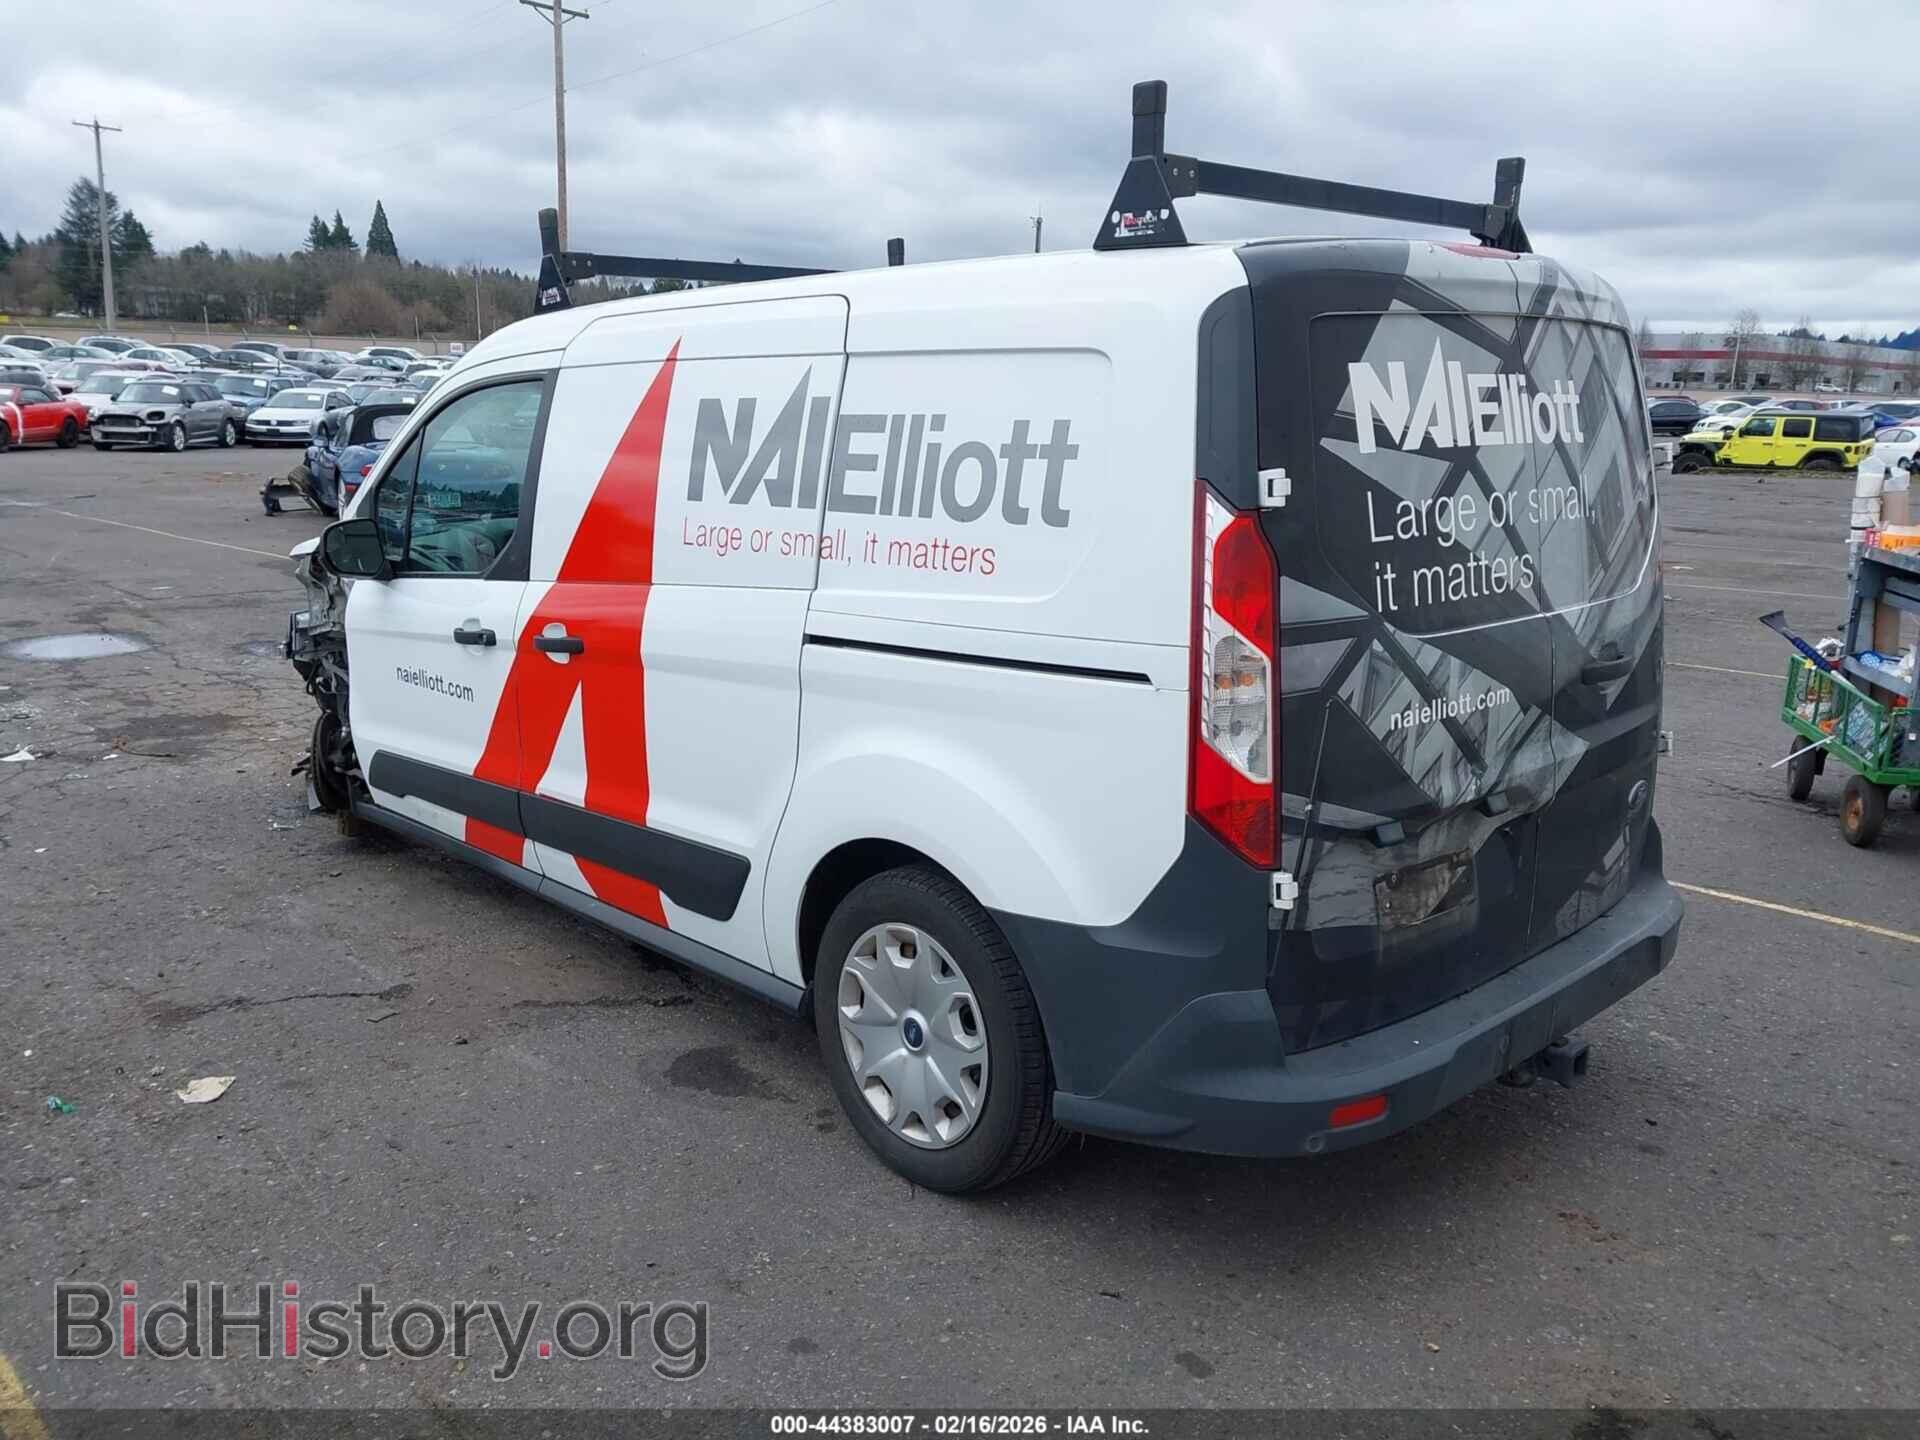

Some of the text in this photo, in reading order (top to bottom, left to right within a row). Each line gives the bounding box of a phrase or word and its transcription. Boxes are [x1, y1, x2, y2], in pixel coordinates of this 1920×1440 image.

[1366, 473, 1597, 547] Large or small,
[682, 516, 996, 575] Large or small, it matters
[1375, 552, 1535, 613] it matters
[396, 665, 474, 703] naielliott.com
[1390, 686, 1511, 731] naielliott.com
